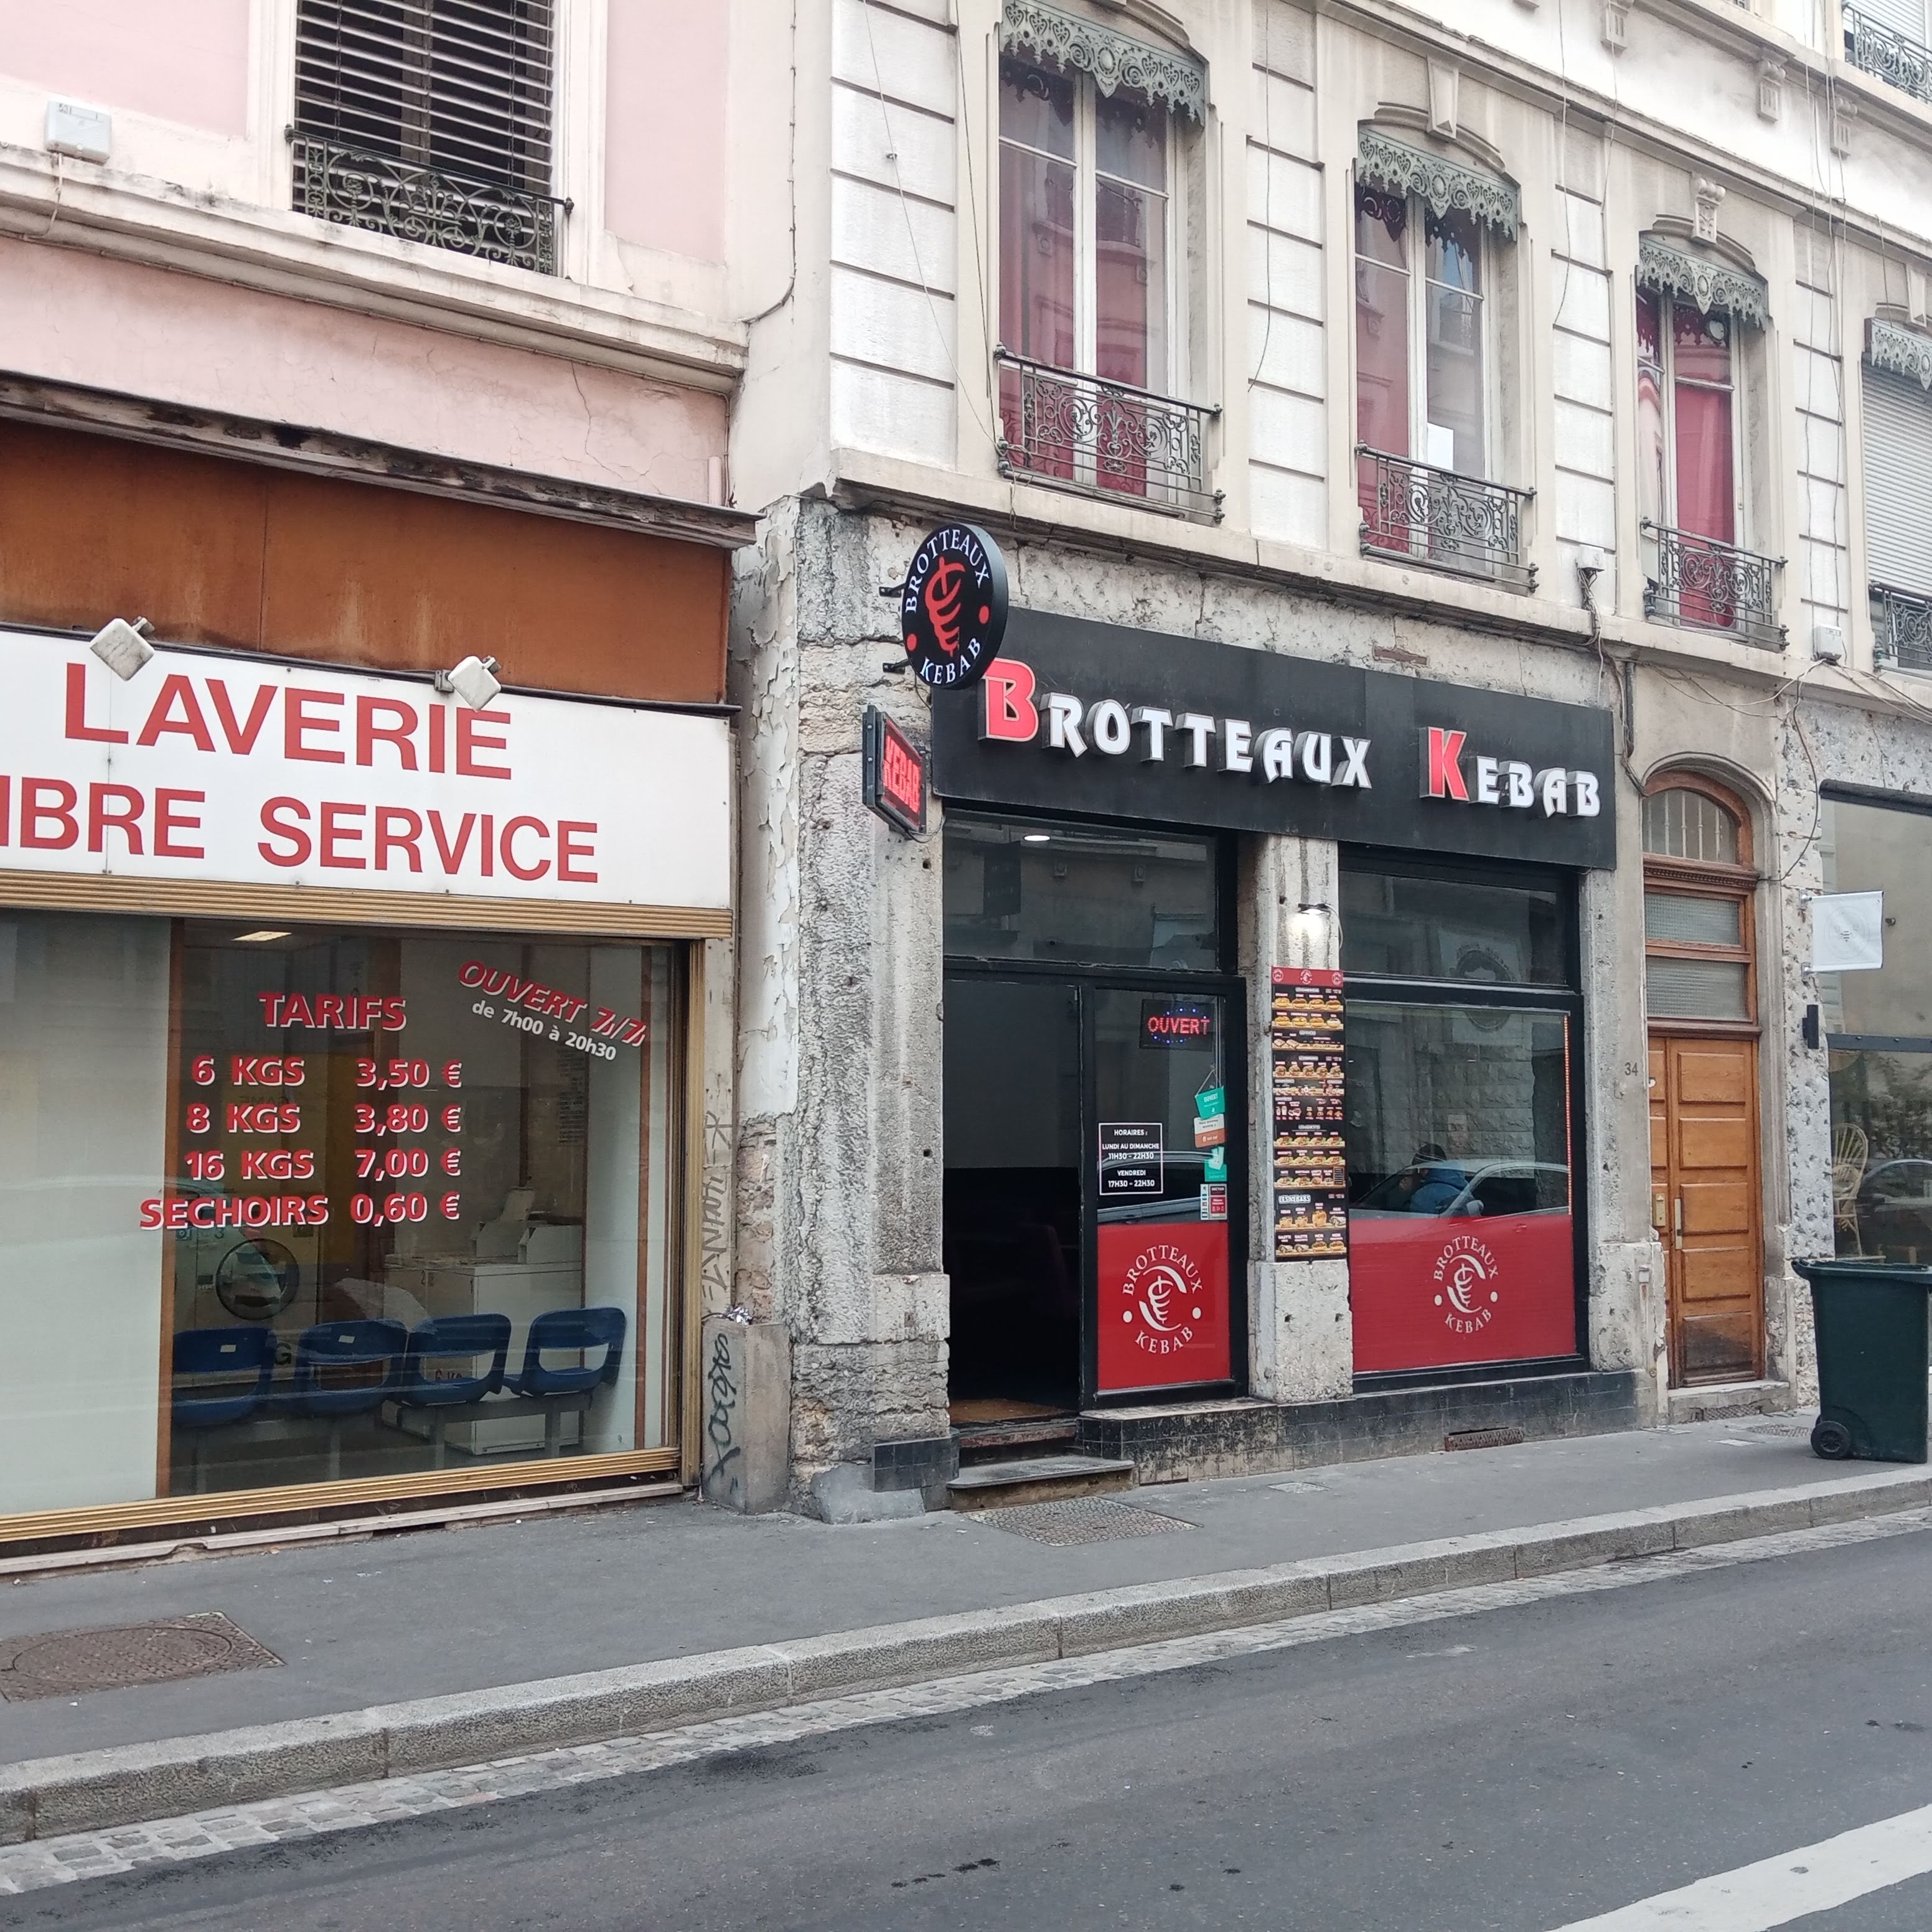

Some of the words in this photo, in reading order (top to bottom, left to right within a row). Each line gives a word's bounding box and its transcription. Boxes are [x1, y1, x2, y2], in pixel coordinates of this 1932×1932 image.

[905, 528, 990, 614] BROTTEAUX
[919, 637, 982, 684] KEBAB
[65, 662, 512, 780] LAVERIE
[980, 657, 1371, 789] BROTTEAUX
[1422, 726, 1601, 818] KEBAB
[258, 796, 599, 883] SERVICE
[259, 993, 407, 1031] TARIFS
[458, 960, 588, 1024] OUVERT
[472, 1000, 495, 1018] de
[500, 1009, 543, 1034] 7h00
[548, 1025, 561, 1041] à
[565, 1032, 617, 1061] 20h30
[1147, 1016, 1210, 1034] OUVERT
[191, 1056, 215, 1086] 6
[231, 1056, 305, 1087] KGS
[355, 1058, 429, 1090] 3,50
[441, 1059, 463, 1088] €
[1625, 1062, 1639, 1076] 34
[185, 1103, 210, 1133] 8
[226, 1104, 301, 1134] KGS
[354, 1104, 429, 1136] 3,80
[440, 1105, 462, 1133] €
[184, 1150, 225, 1181] 16
[241, 1149, 315, 1179] KGS
[355, 1148, 429, 1181] 7,00
[440, 1148, 462, 1176] €
[139, 1195, 329, 1231] SECHOIRS
[349, 1191, 428, 1227] 0,60
[439, 1191, 461, 1221] €
[1122, 1245, 1203, 1296] BROTTEAUX
[1433, 1236, 1498, 1281] BROTTEAUX
[1135, 1326, 1193, 1354] KEBAB
[1444, 1309, 1492, 1334] KEBAB
